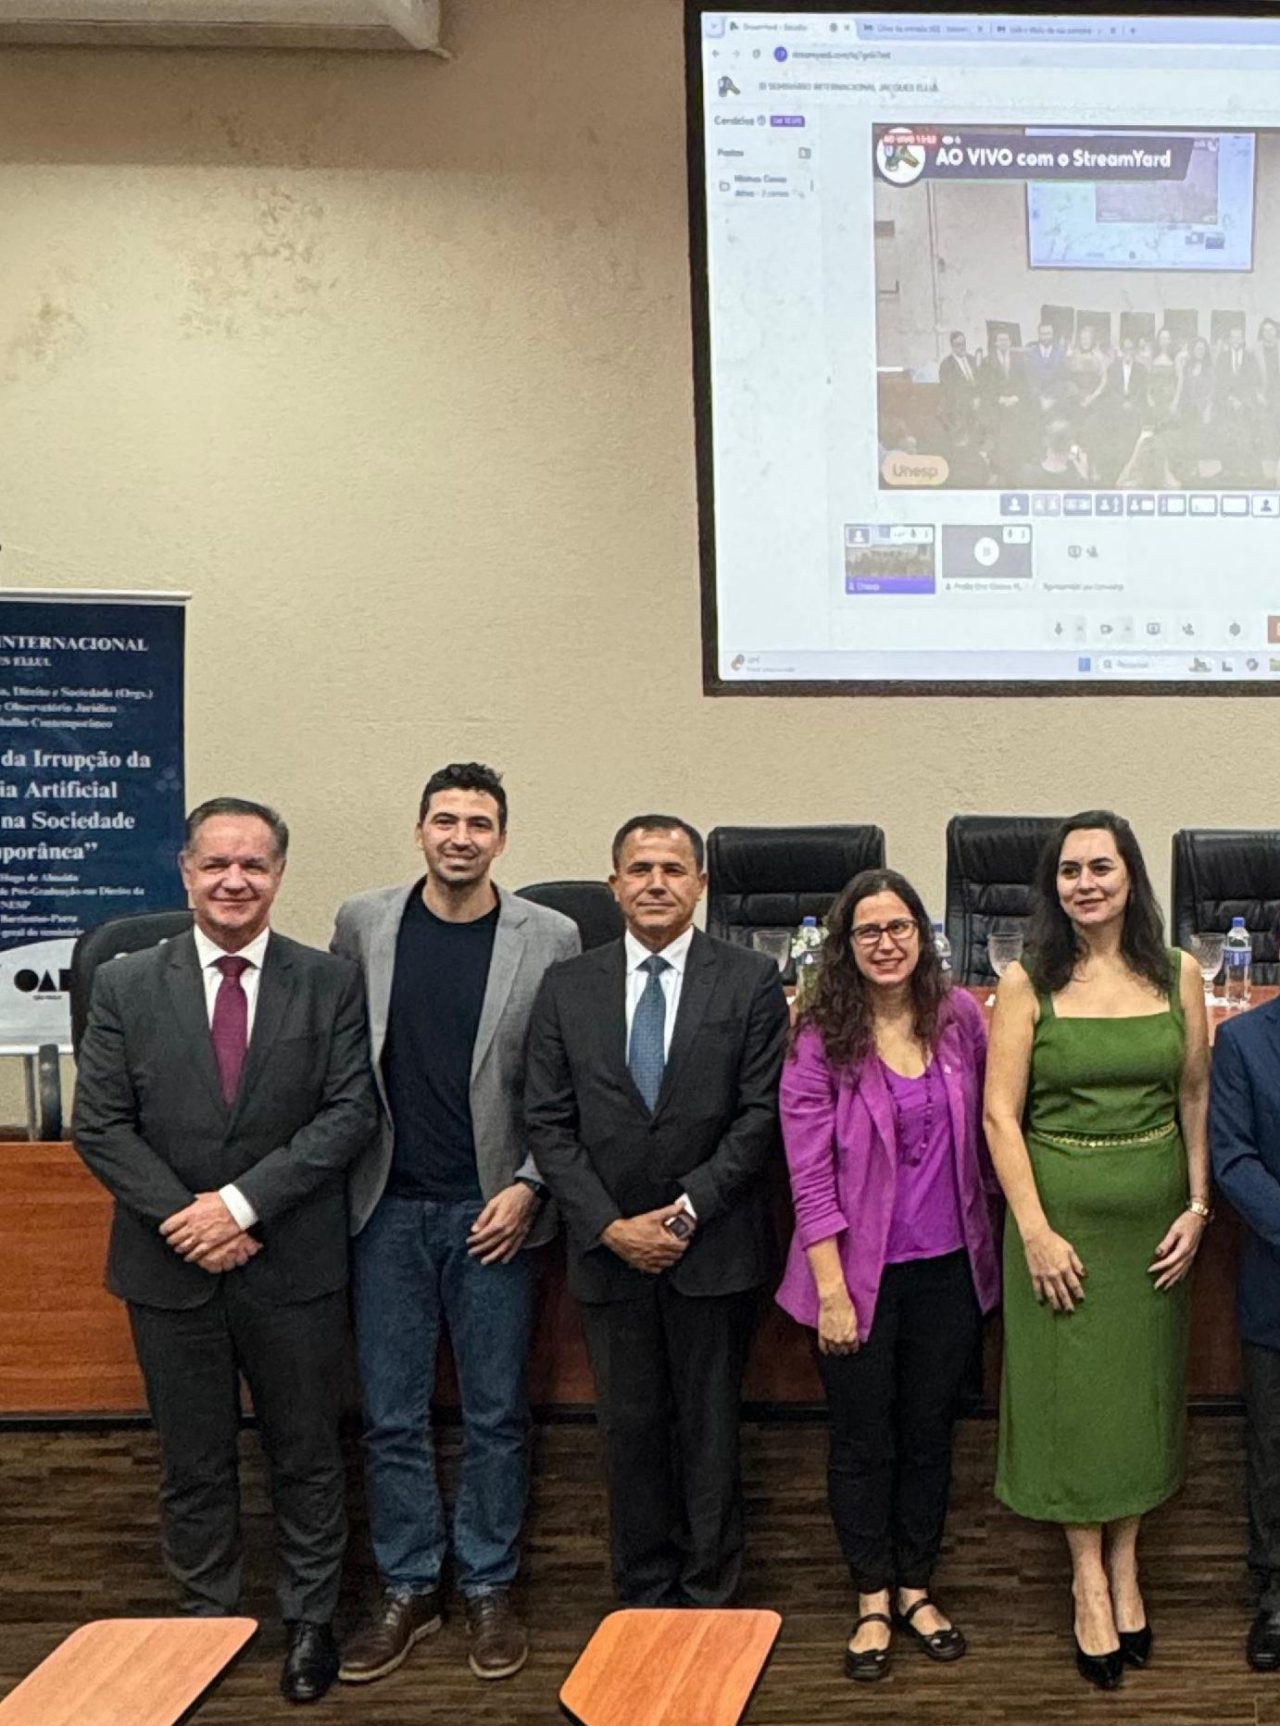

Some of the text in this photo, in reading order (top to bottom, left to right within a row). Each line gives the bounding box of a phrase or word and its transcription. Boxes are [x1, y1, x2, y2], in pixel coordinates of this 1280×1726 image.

[935, 147, 1172, 168] AO VIVO com o StreamYard
[892, 462, 938, 478] Unesp
[115, 688, 154, 700] (Orgs.)
[1, 749, 152, 772] da Irrupção da
[24, 780, 118, 799] Artificial
[1, 811, 136, 829] na Sociedade
